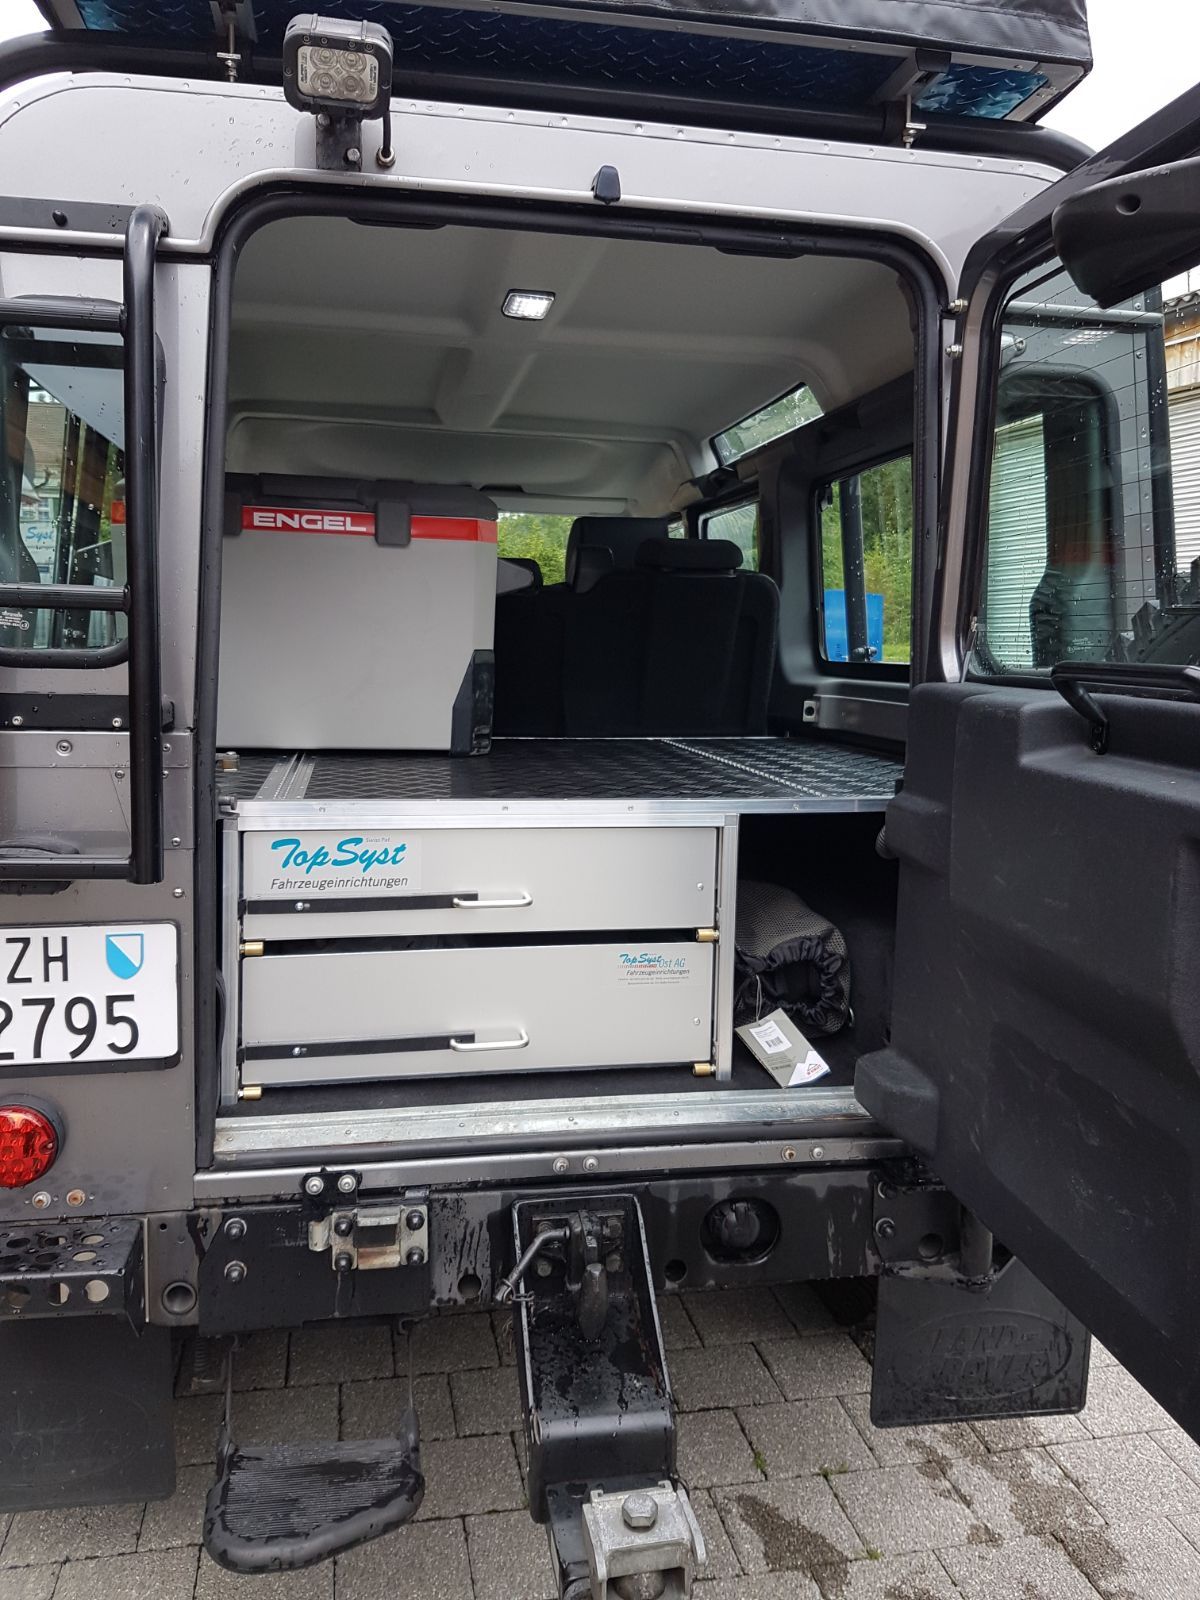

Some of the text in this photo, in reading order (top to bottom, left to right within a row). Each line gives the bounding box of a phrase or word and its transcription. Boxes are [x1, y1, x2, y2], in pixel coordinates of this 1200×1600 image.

[253, 511, 367, 532] ENGEL
[270, 876, 408, 891] Fahrzeugeinrichtungen
[5, 936, 69, 984] ZH
[673, 957, 686, 968] AG
